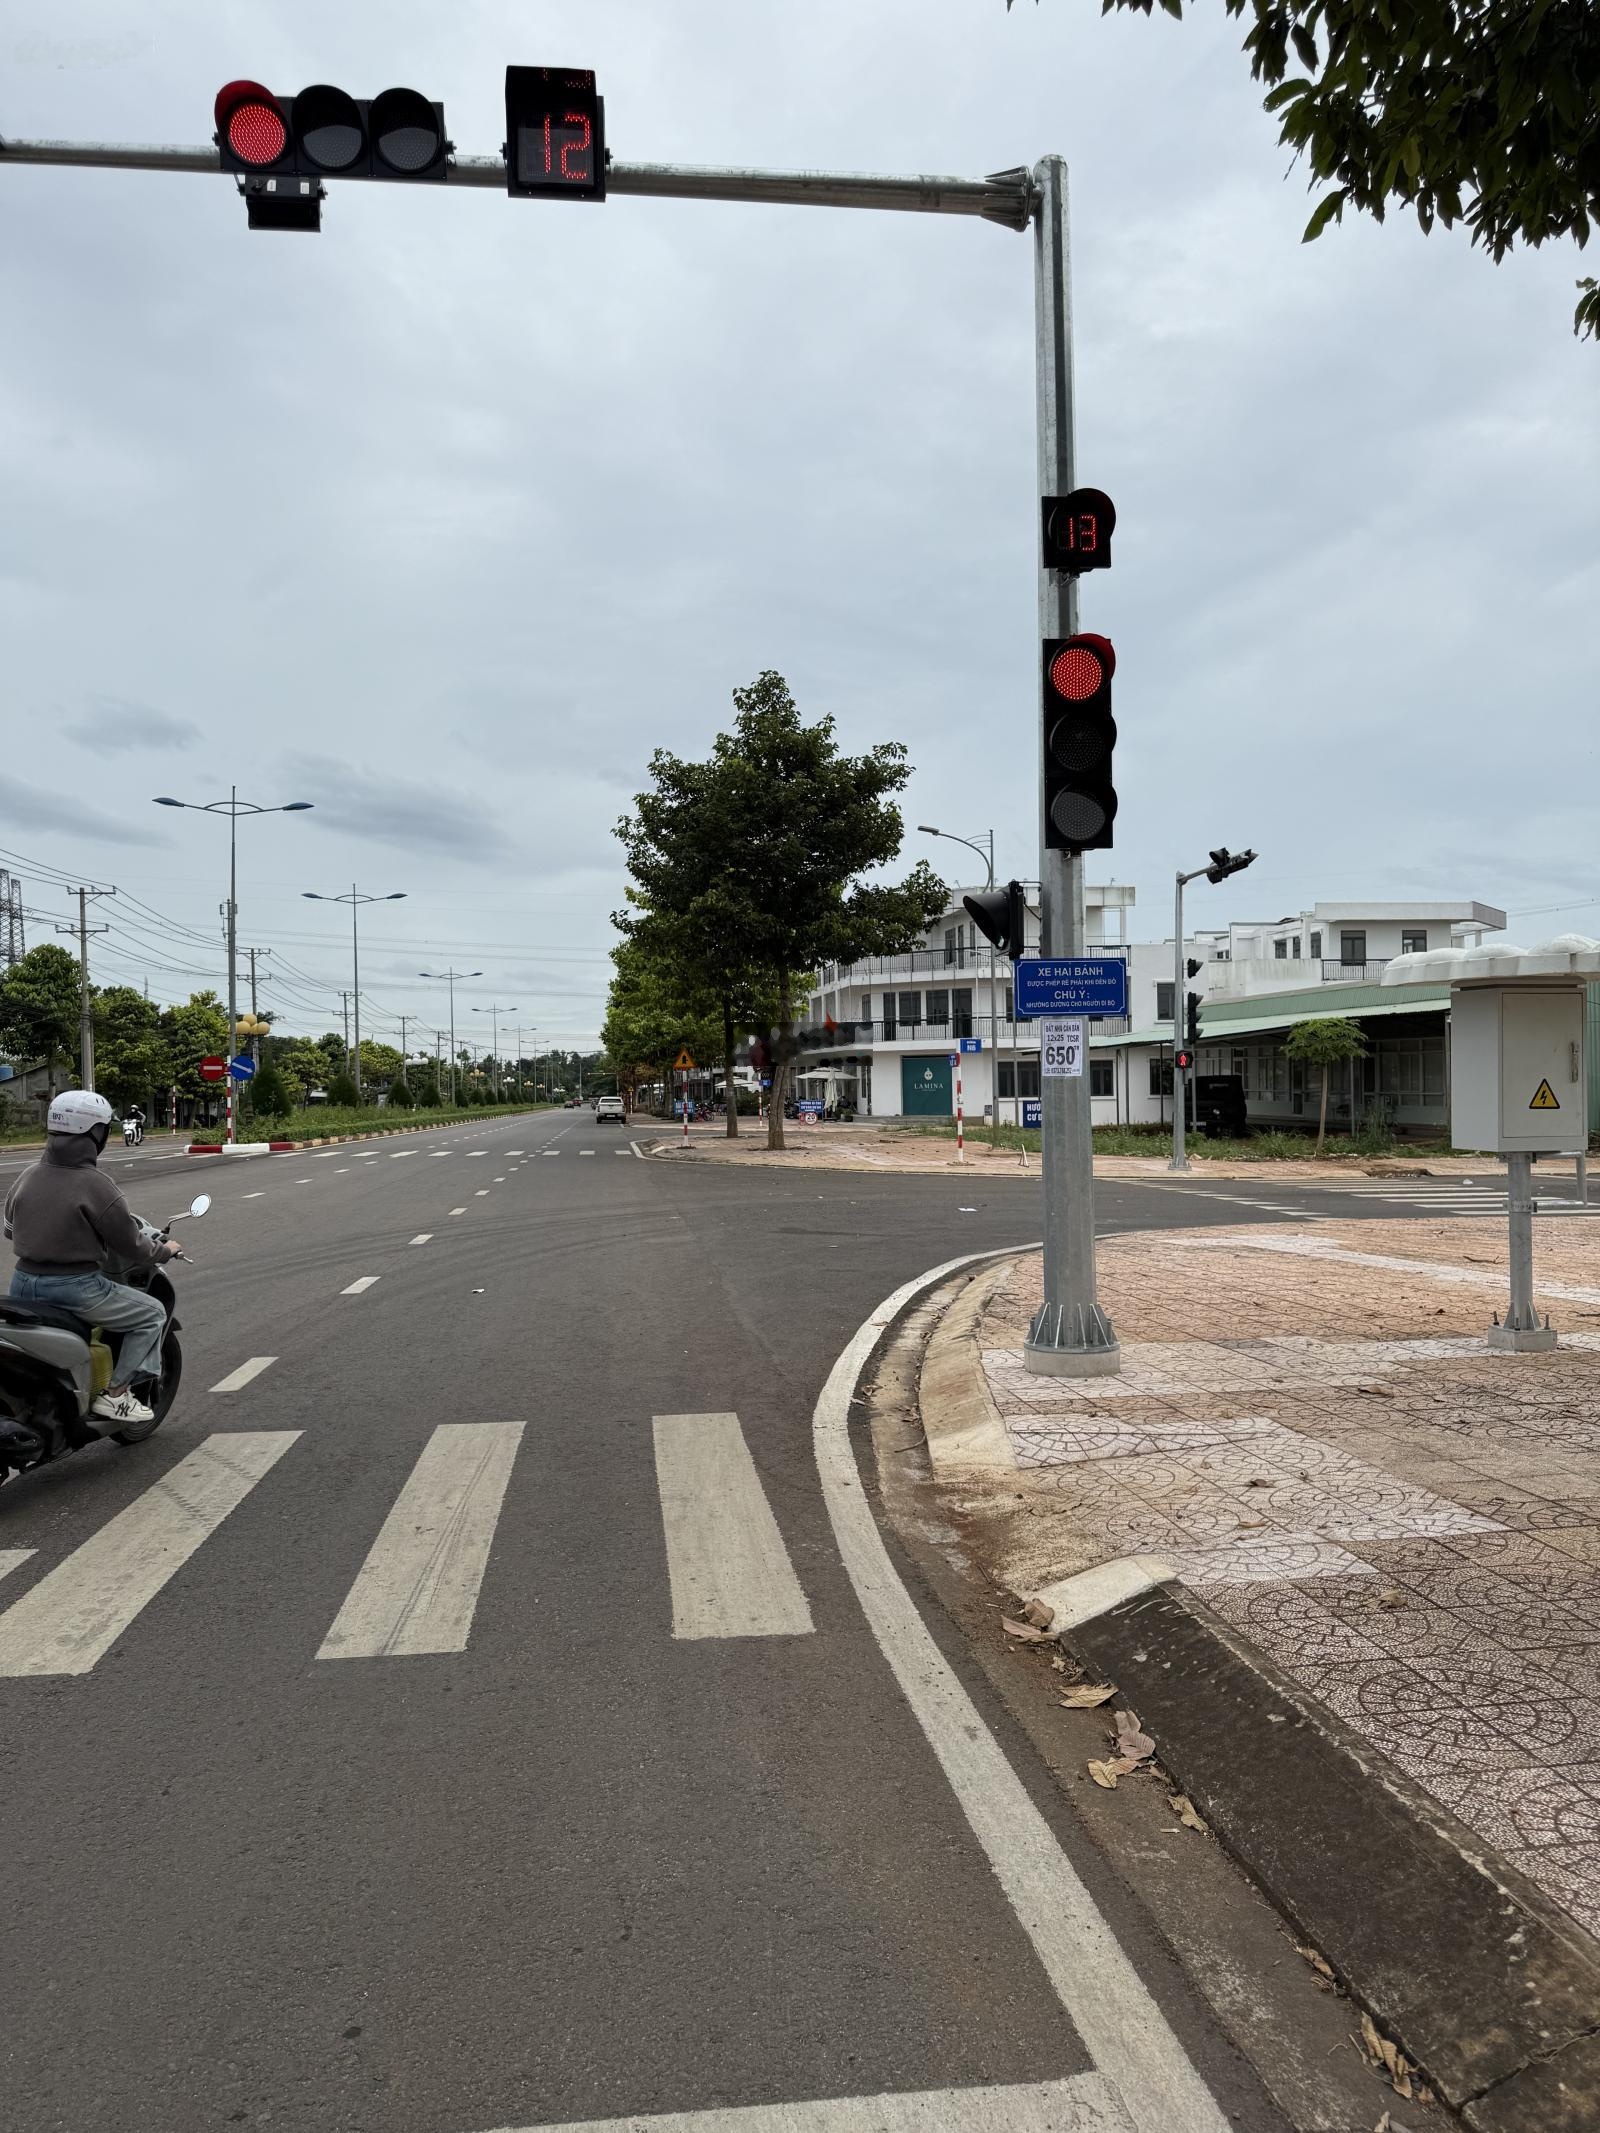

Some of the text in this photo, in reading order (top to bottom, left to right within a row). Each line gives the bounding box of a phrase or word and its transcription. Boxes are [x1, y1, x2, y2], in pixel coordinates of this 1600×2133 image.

[543, 112, 592, 180] 12
[1068, 514, 1097, 551] 13
[1038, 964, 1103, 977] XE HAI BÁNH
[1045, 978, 1061, 987] PHÉP
[1070, 977, 1084, 986] PHẢI
[1054, 986, 1076, 1000] CHÚ
[1046, 1046, 1075, 1065] 650
